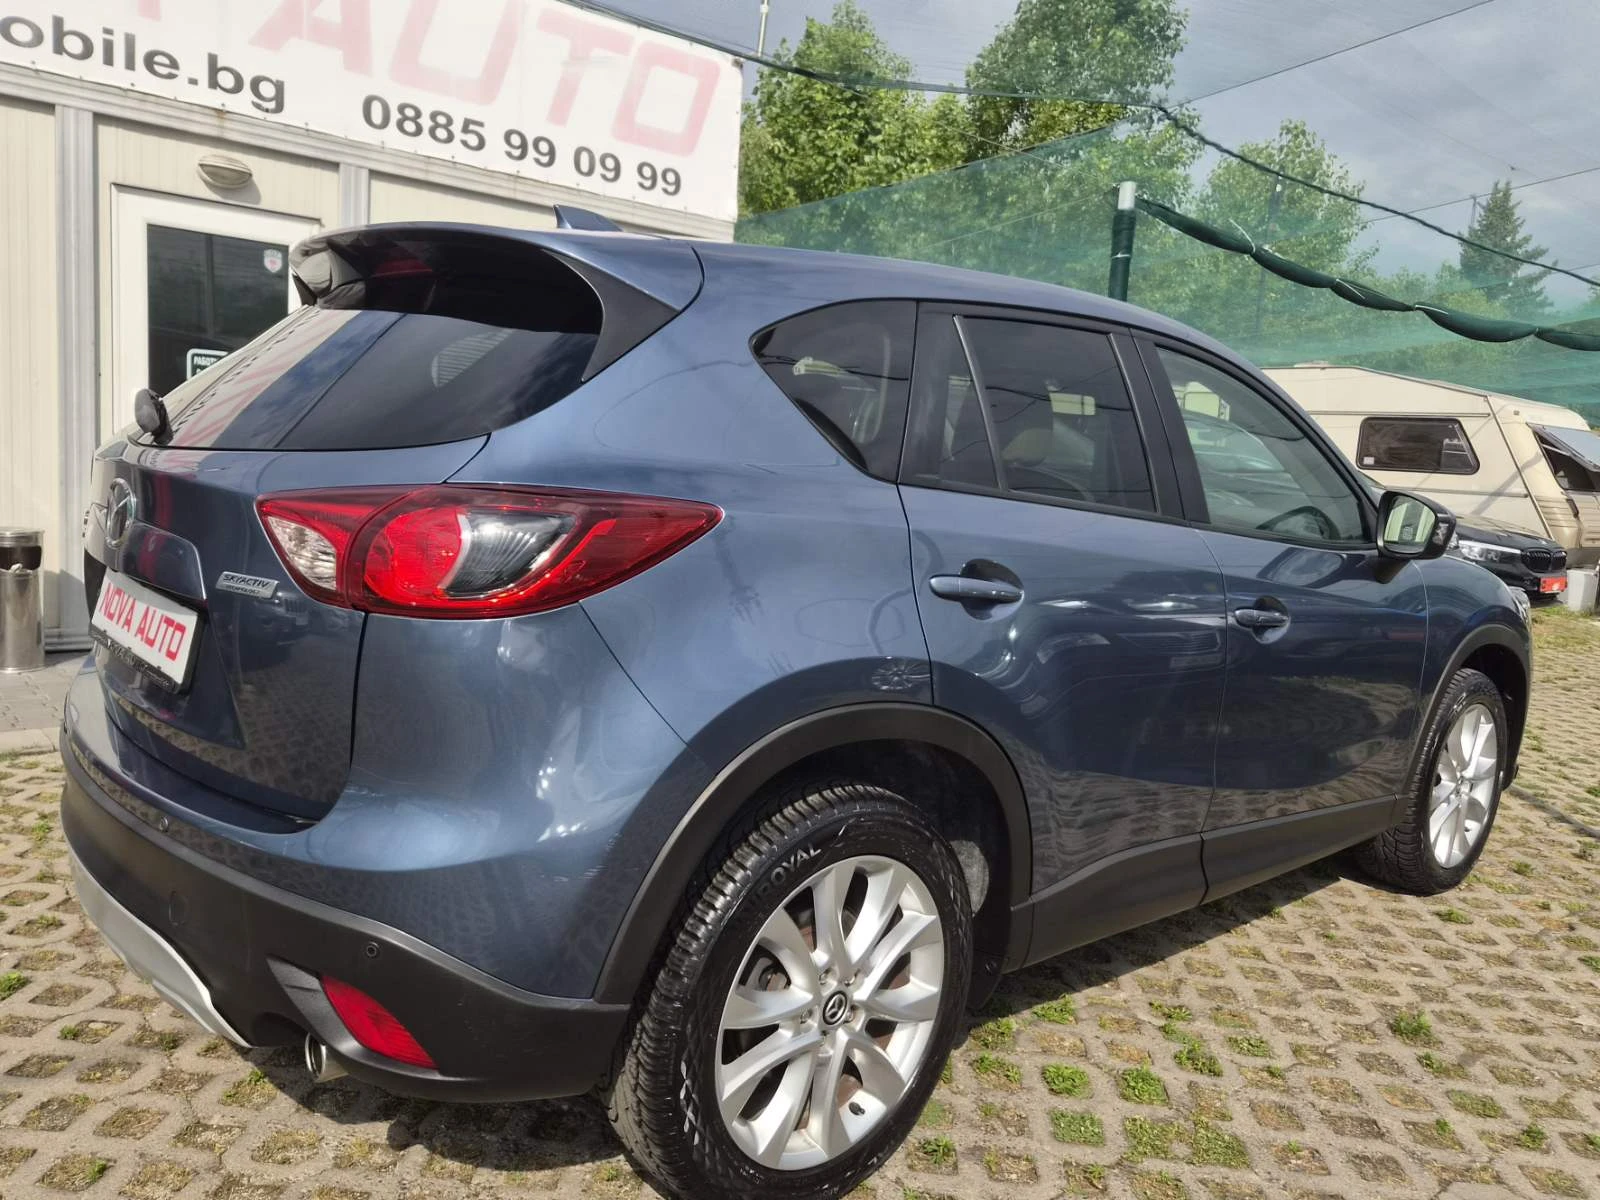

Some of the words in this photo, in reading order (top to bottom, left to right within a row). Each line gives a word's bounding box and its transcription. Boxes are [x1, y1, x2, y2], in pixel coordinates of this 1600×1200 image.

[0, 15, 285, 114] obile.bg
[248, 0, 721, 157] AUTO
[362, 94, 486, 151] 0885
[503, 128, 556, 168] 99
[573, 146, 621, 183] 09
[636, 161, 682, 197] 99
[99, 582, 136, 633] NOVA
[134, 605, 186, 662] AUTO
[222, 574, 271, 588] SKYACTIV
